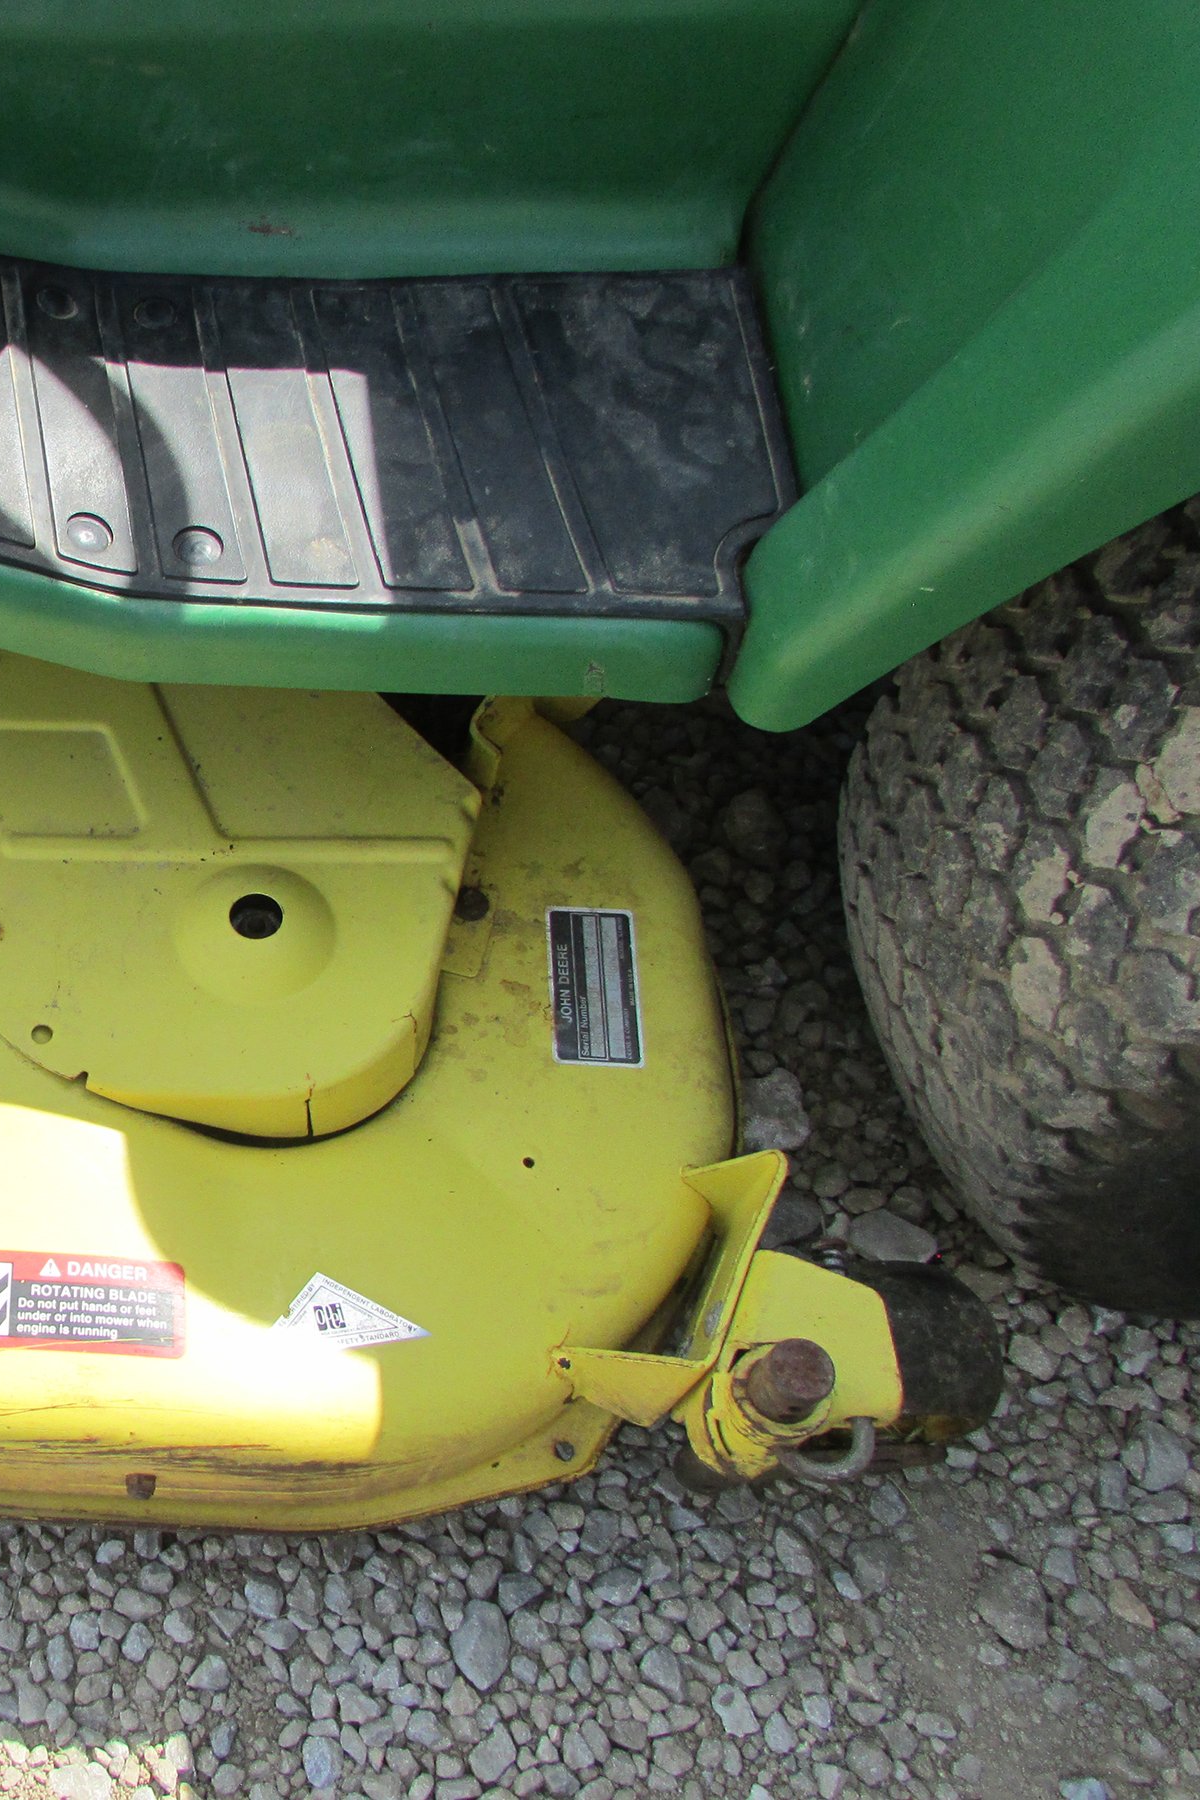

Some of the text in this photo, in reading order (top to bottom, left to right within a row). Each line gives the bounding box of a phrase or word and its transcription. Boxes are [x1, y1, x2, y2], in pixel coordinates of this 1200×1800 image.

[556, 943, 572, 1022] JOHN DEERE
[578, 995, 589, 1056] Serial Number
[67, 1261, 147, 1281] DANGER
[31, 1284, 157, 1303] ROTATING BLADE
[322, 1278, 370, 1307] INDEPENDENT
[18, 1297, 156, 1316] Do not put hands or feet
[17, 1311, 167, 1329] under or into mower when
[17, 1324, 118, 1340] engine is running
